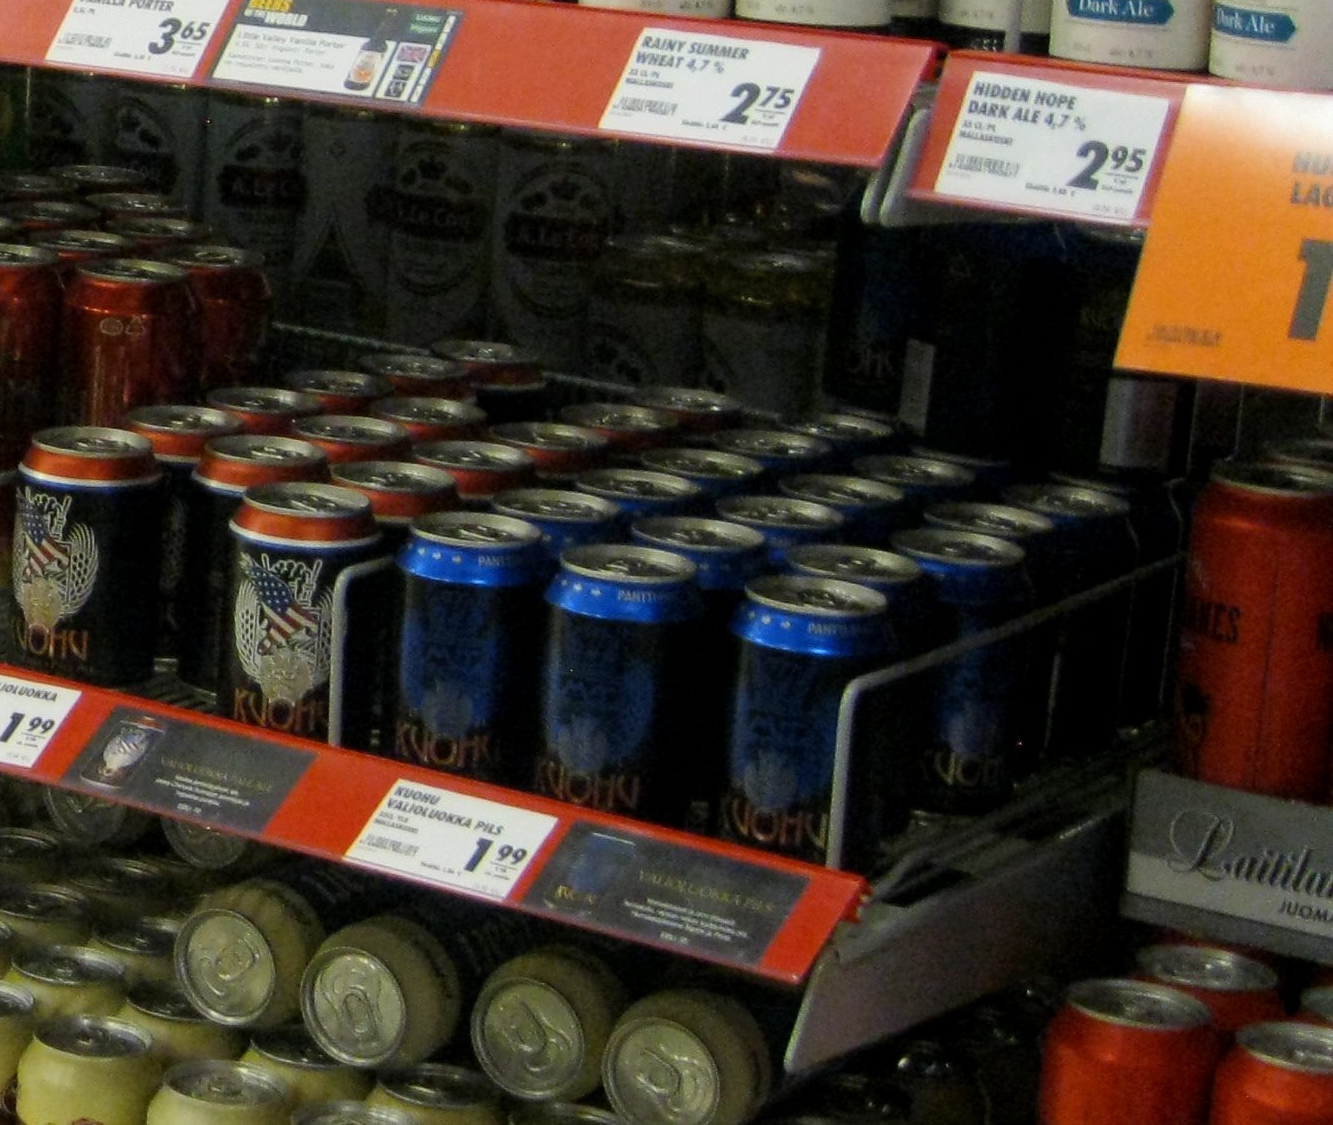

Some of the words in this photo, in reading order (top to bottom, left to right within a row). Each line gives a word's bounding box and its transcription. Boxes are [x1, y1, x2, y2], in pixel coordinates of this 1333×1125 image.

[1250, 14, 1277, 34] Ale
[641, 36, 684, 52] RAINY
[688, 42, 750, 60] SUMMER
[635, 51, 684, 68] WHEAT
[686, 58, 710, 73] 4,7
[973, 81, 1031, 104] HIDDEN
[1034, 90, 1077, 110] HOPE
[967, 100, 1008, 120] DARK
[1012, 105, 1041, 125] ALE
[1044, 111, 1071, 130] 4,7
[394, 784, 440, 805] KUOHU
[386, 797, 474, 830] VALIOLUOKKA
[476, 819, 506, 837] PILS
